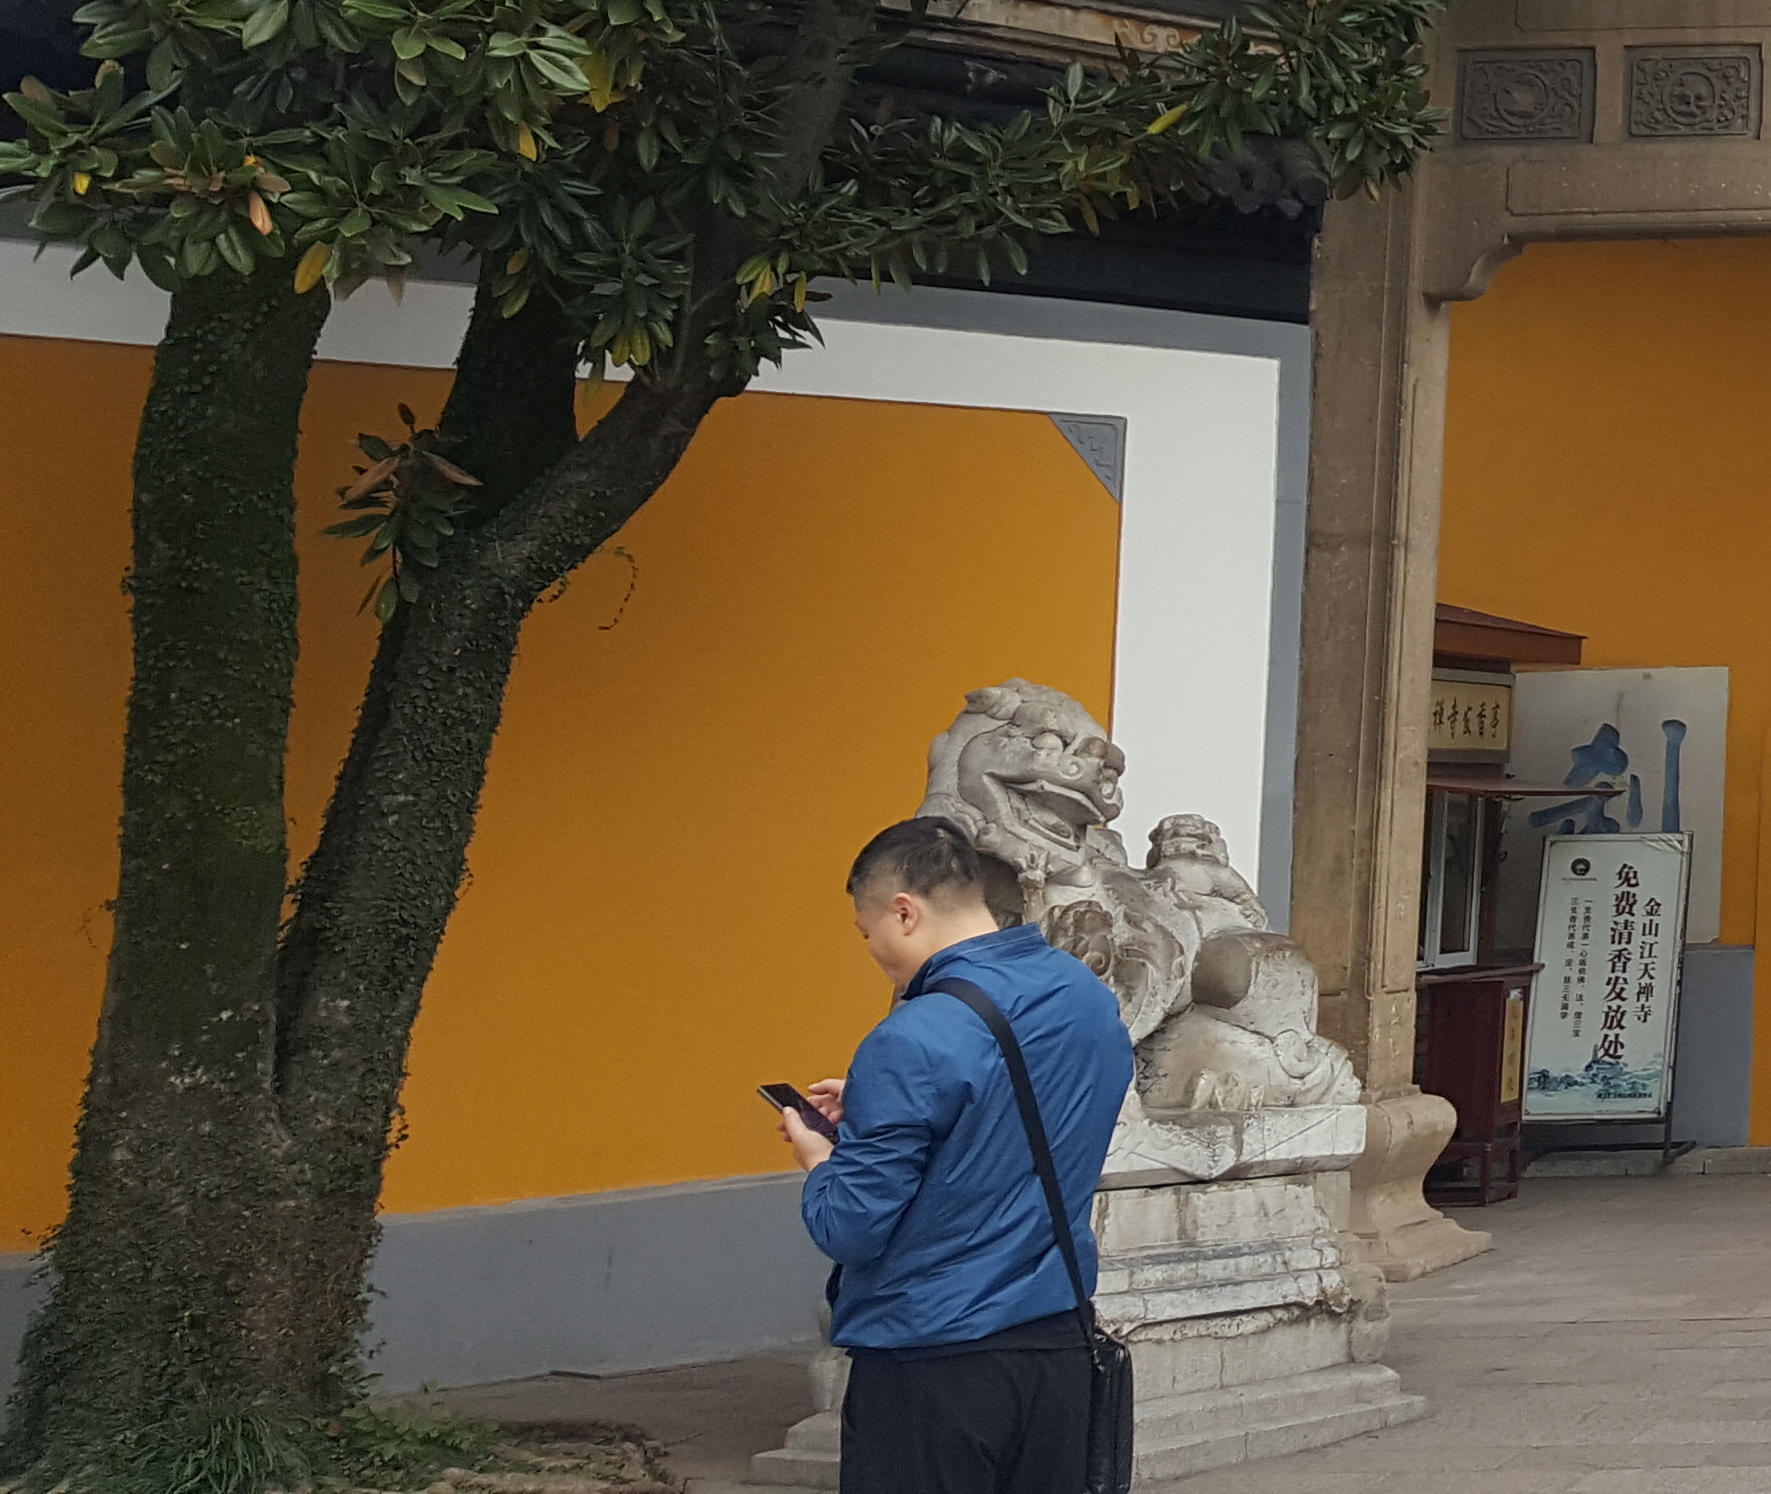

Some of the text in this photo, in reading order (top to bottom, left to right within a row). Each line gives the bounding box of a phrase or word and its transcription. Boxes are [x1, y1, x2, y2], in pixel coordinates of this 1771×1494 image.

[1597, 863, 1641, 1060] 免费清香发放处
[1633, 897, 1662, 1024] 金山江天禅寺
